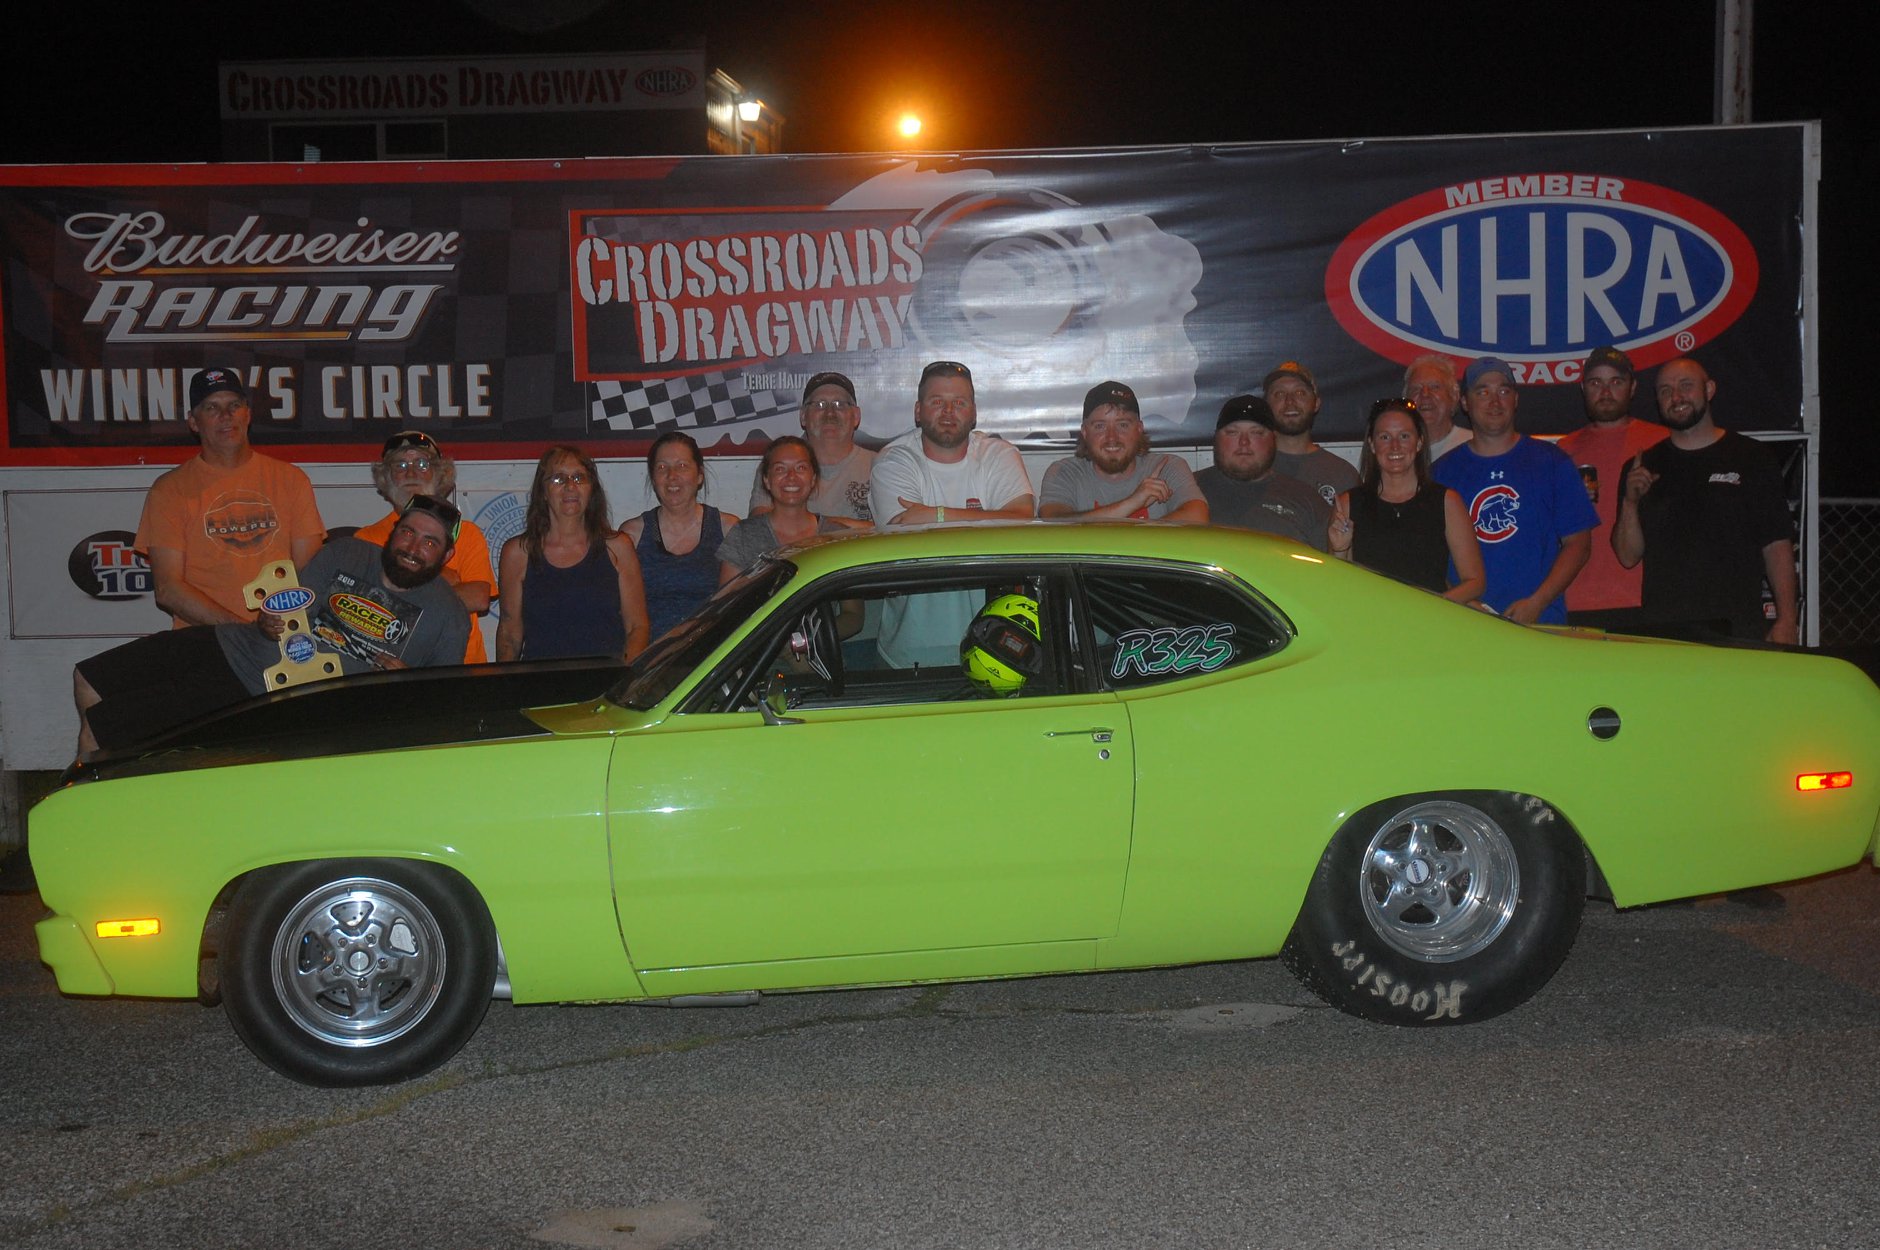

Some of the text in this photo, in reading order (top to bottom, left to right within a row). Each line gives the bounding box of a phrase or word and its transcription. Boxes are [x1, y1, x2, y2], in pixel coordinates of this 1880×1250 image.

[227, 66, 629, 113] CROSSROADS DRAGWAY
[643, 71, 692, 93] NHRA
[1444, 174, 1625, 209] MEMBER
[64, 211, 460, 273] Budweiser
[576, 225, 924, 306] CROSSROADS
[1395, 211, 1697, 346] NHRA
[638, 294, 914, 364] DRAGWAY
[740, 371, 777, 391] TERRE
[1507, 360, 1586, 385] RAC
[40, 364, 492, 422] WINN'S CIRCLE
[484, 494, 519, 521] UNION
[487, 509, 526, 546] GANIZED
[268, 590, 308, 611] NHRA
[336, 597, 392, 628] RACER
[1111, 622, 1237, 679] R325
